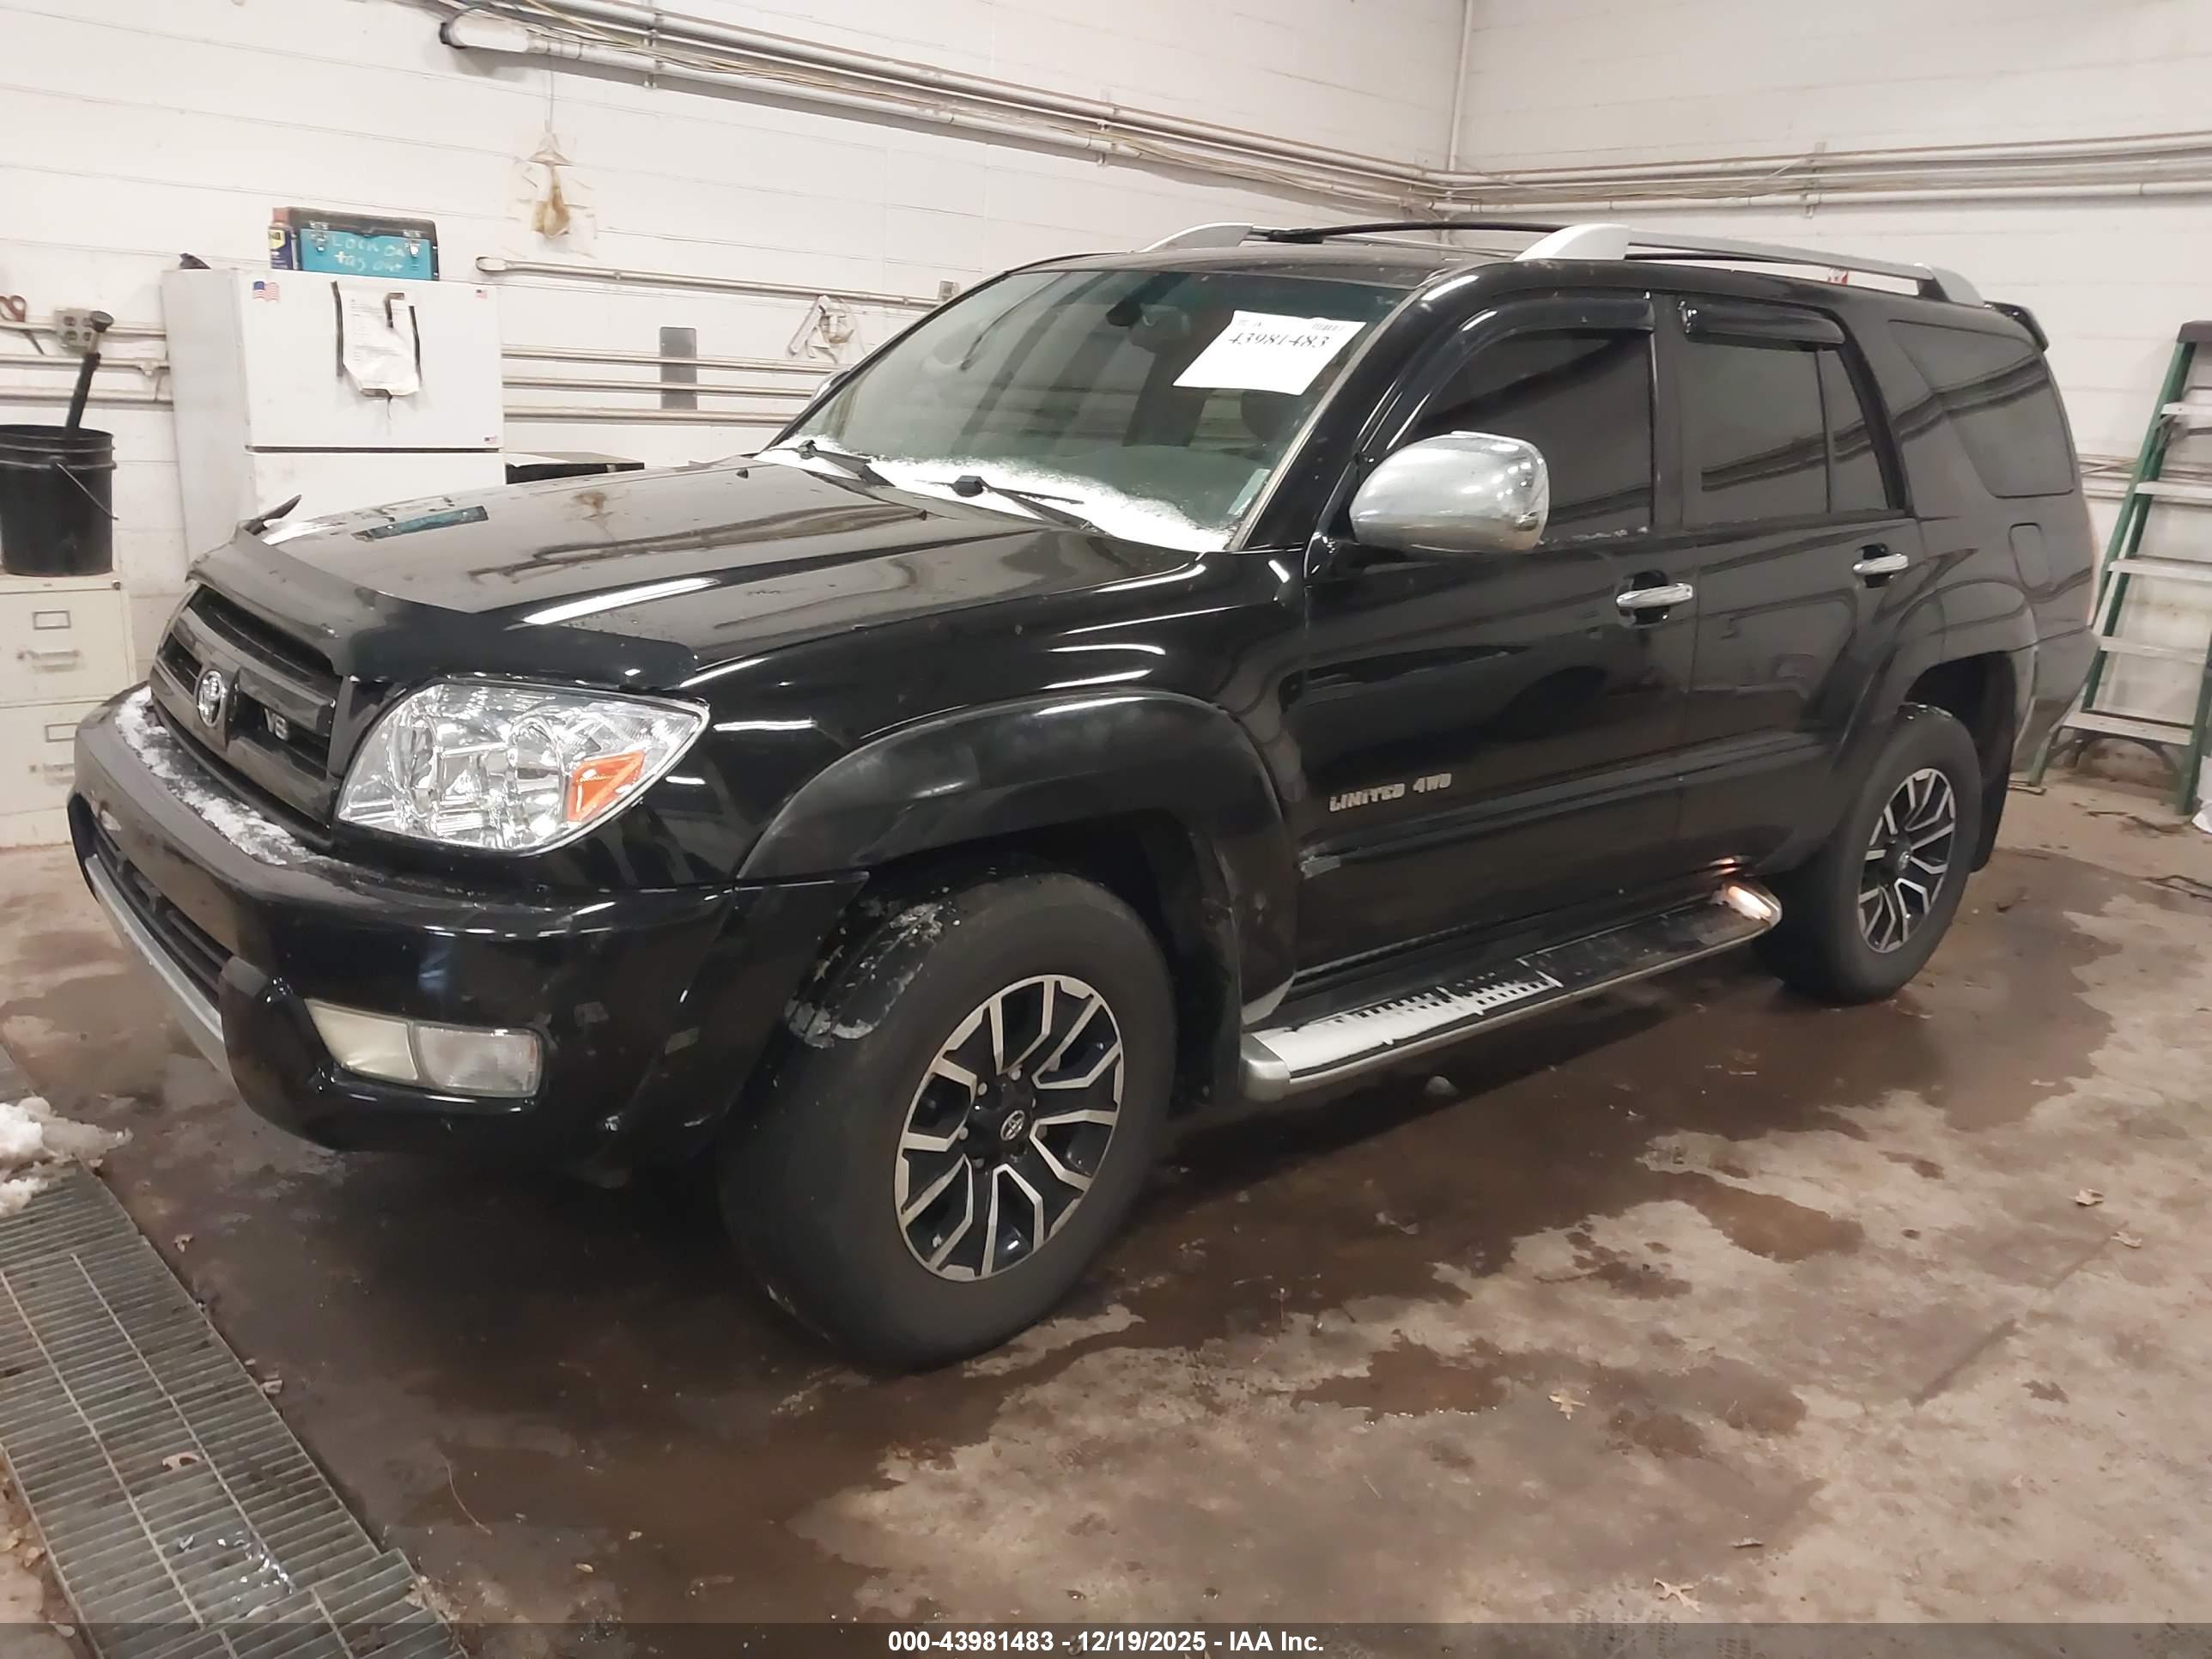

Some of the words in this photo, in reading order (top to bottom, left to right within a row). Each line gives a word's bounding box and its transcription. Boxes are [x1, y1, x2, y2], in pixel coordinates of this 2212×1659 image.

[1228, 332, 1330, 348] 43981483
[264, 708, 289, 741] V8
[1329, 783, 1406, 812] LIMITED
[1413, 773, 1452, 793] 4WD
